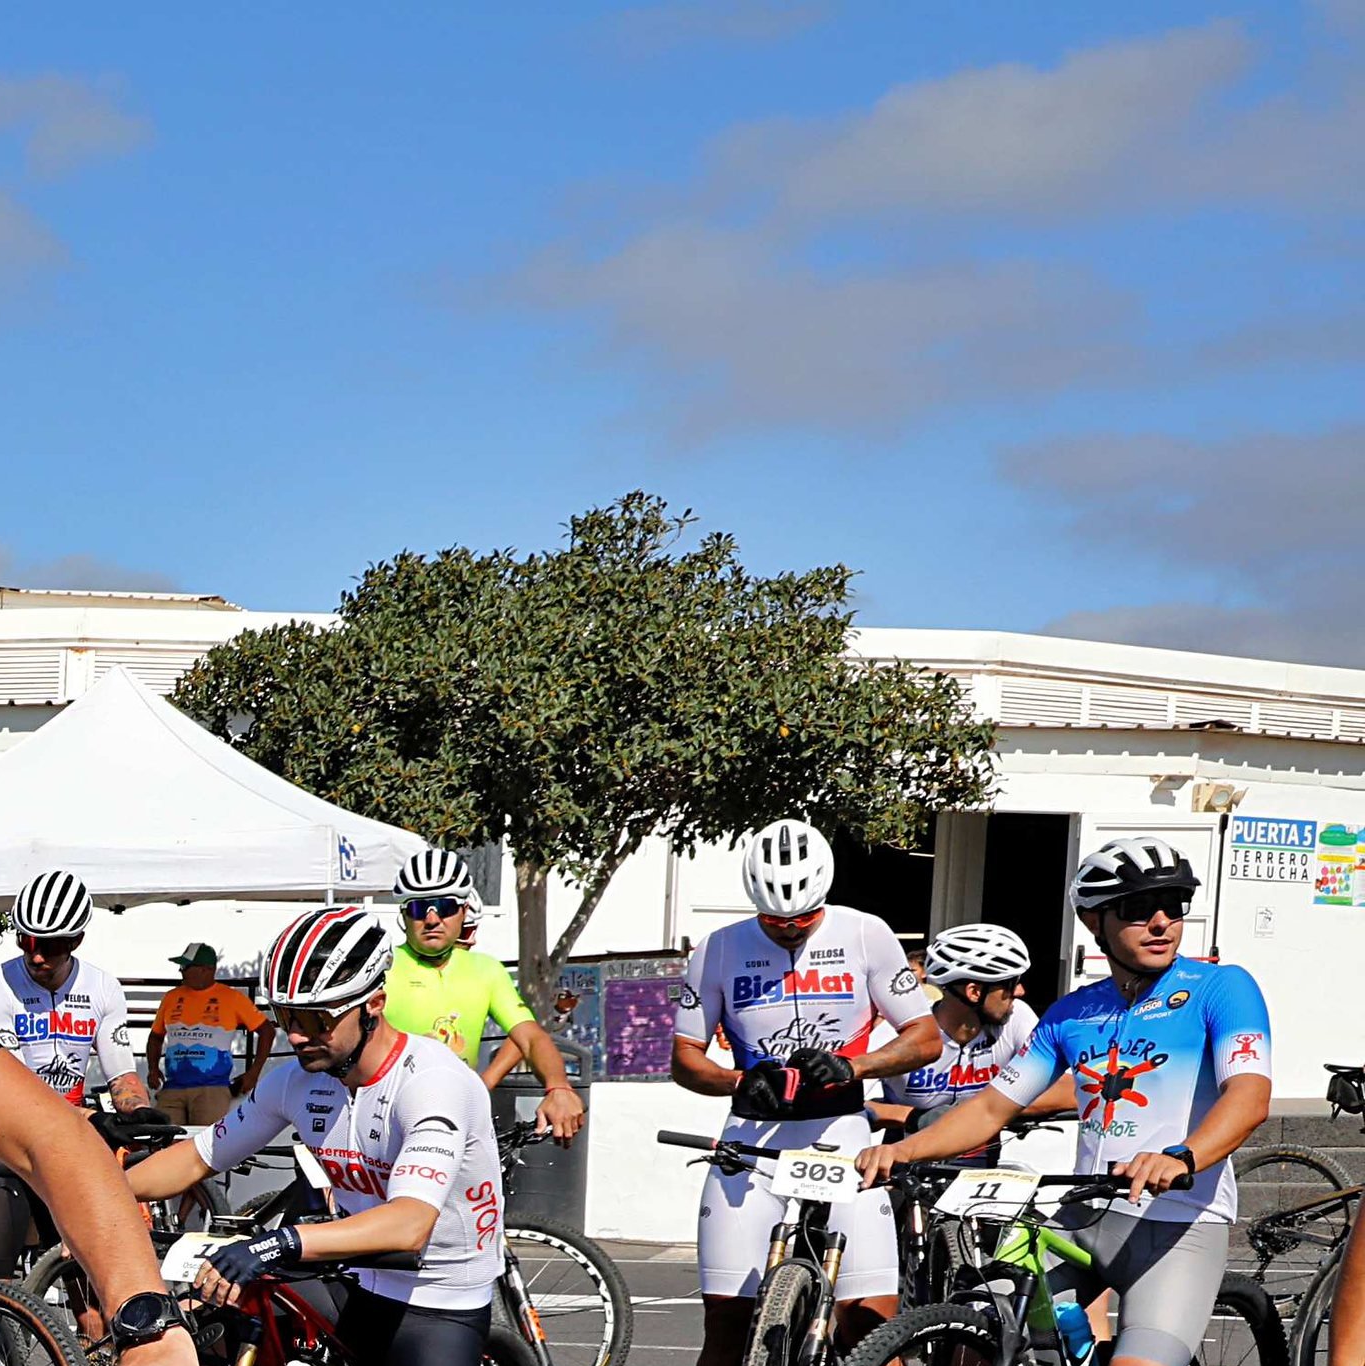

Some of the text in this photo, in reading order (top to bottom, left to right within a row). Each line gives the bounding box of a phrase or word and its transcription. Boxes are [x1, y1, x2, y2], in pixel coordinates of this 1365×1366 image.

[1232, 820, 1313, 846] PUERTA 5
[1232, 849, 1308, 867] TERRERO
[1230, 864, 1308, 880] DE LUCHA
[810, 948, 845, 959] VELOSA
[732, 968, 855, 1004] BigMat
[65, 993, 90, 1003] VELOSA
[15, 1010, 97, 1041] BigMat
[772, 1016, 817, 1041] La
[789, 1161, 846, 1183] 303
[970, 1182, 1002, 1201] 11
[249, 1236, 280, 1255] FROIZ
